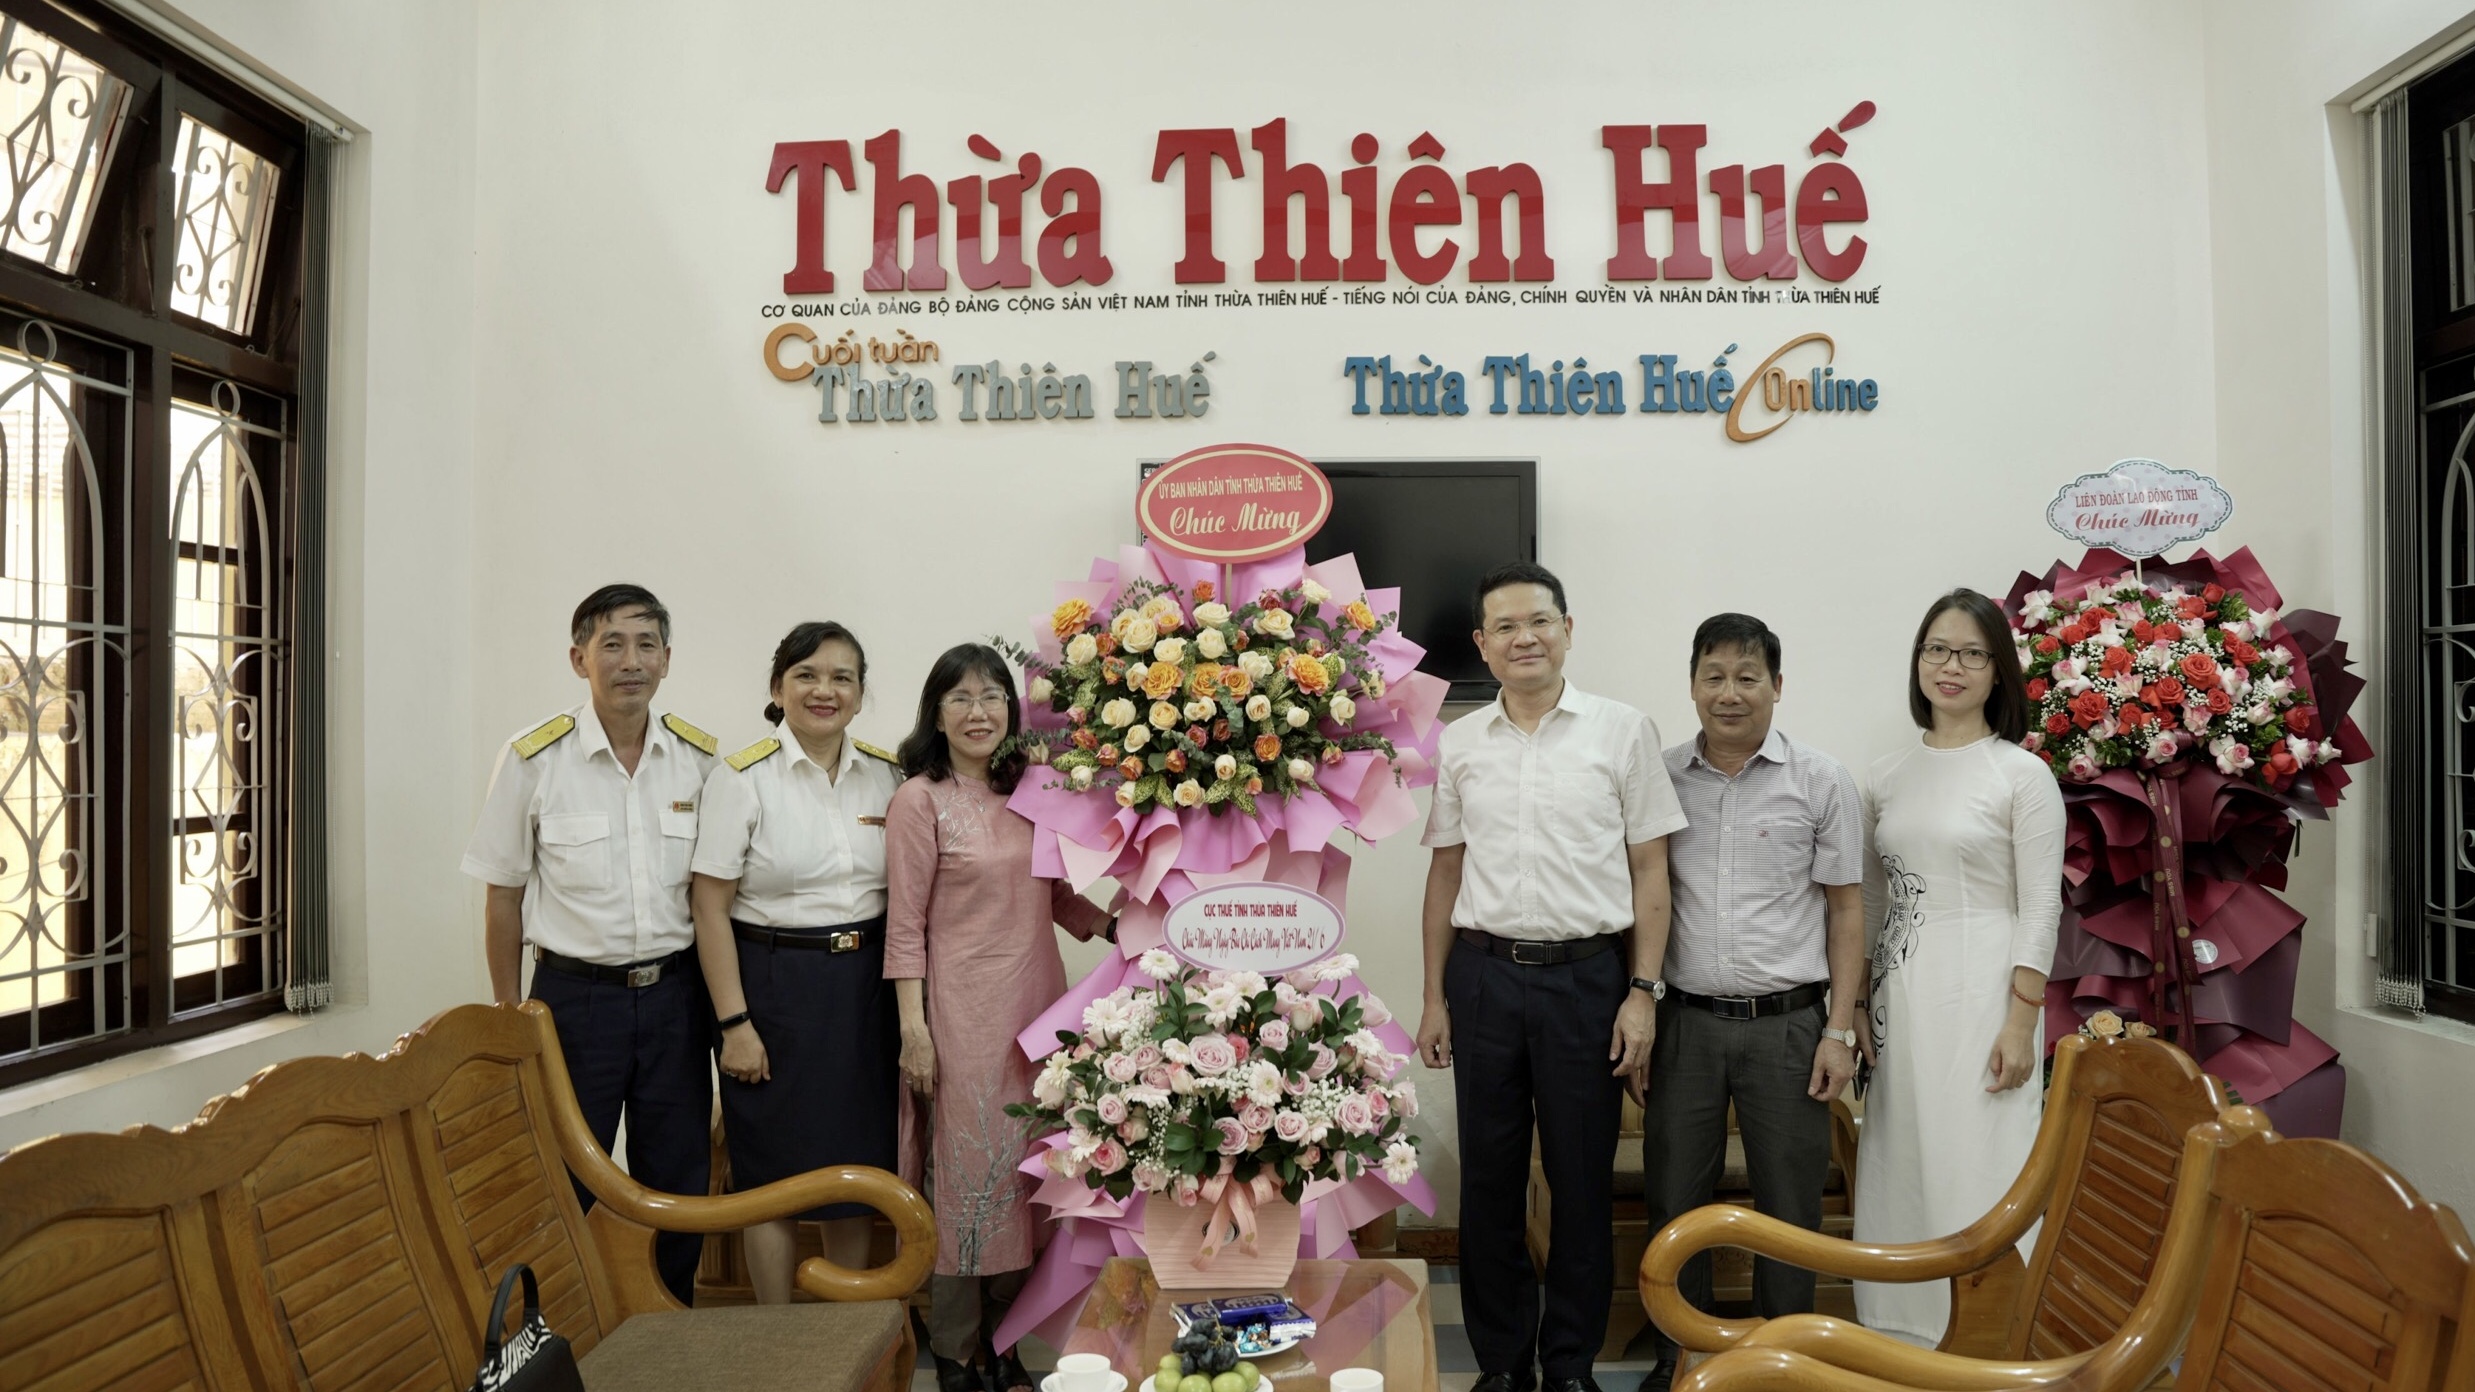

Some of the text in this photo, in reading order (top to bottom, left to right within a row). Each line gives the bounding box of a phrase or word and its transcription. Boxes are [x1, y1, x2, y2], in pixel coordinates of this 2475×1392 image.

[765, 100, 1877, 294] Thừa Thiên Huế
[762, 305, 785, 317] CƠ
[792, 304, 834, 317] QUAN
[840, 297, 871, 316] CỦA
[877, 296, 921, 315] ĐẢNG
[929, 298, 949, 317] BỘ
[955, 295, 999, 313] ĐẢNG
[1008, 295, 1055, 314] CỘNG
[1062, 291, 1091, 310] SẢN
[1098, 293, 1127, 312] VIỆT
[1134, 295, 1169, 308] NAM
[1176, 289, 1207, 308] TỈNH
[1215, 290, 1252, 307] THỪA
[1257, 289, 1296, 306] THIÊN
[1301, 286, 1330, 305] HUẾ
[1343, 285, 1385, 305] TIẾNG
[1393, 285, 1419, 304] NÓI
[1426, 284, 1458, 304] CỦA
[1465, 285, 1516, 306] ĐẢNG,
[1521, 285, 1567, 304] CHÍNH
[1575, 284, 1625, 304] QUYỀN
[1633, 284, 1653, 303] VÀ
[1660, 286, 1701, 303] NHÂN
[1707, 286, 1737, 304] DÂN
[1743, 286, 1770, 304] TỈNH
[1814, 286, 1850, 304] THIÊN
[1855, 285, 1881, 304] HUẾ
[763, 322, 939, 382] Cuối tuần
[812, 350, 1216, 422] Thừa Thiên Huế
[1344, 342, 1878, 415] Thừa Thiên Huế Online
[1159, 470, 1303, 499] ỦY BAN NHÂN DÂN TỈNH THỪA THIÊN HUẾ
[2075, 485, 2198, 508] LIÊN ĐOÀN LAO ĐỘNG TỈNH
[1170, 502, 1302, 536] Chúc Mừng
[2075, 508, 2199, 531] Chúc Mừng
[2164, 868, 2172, 881] YOU
